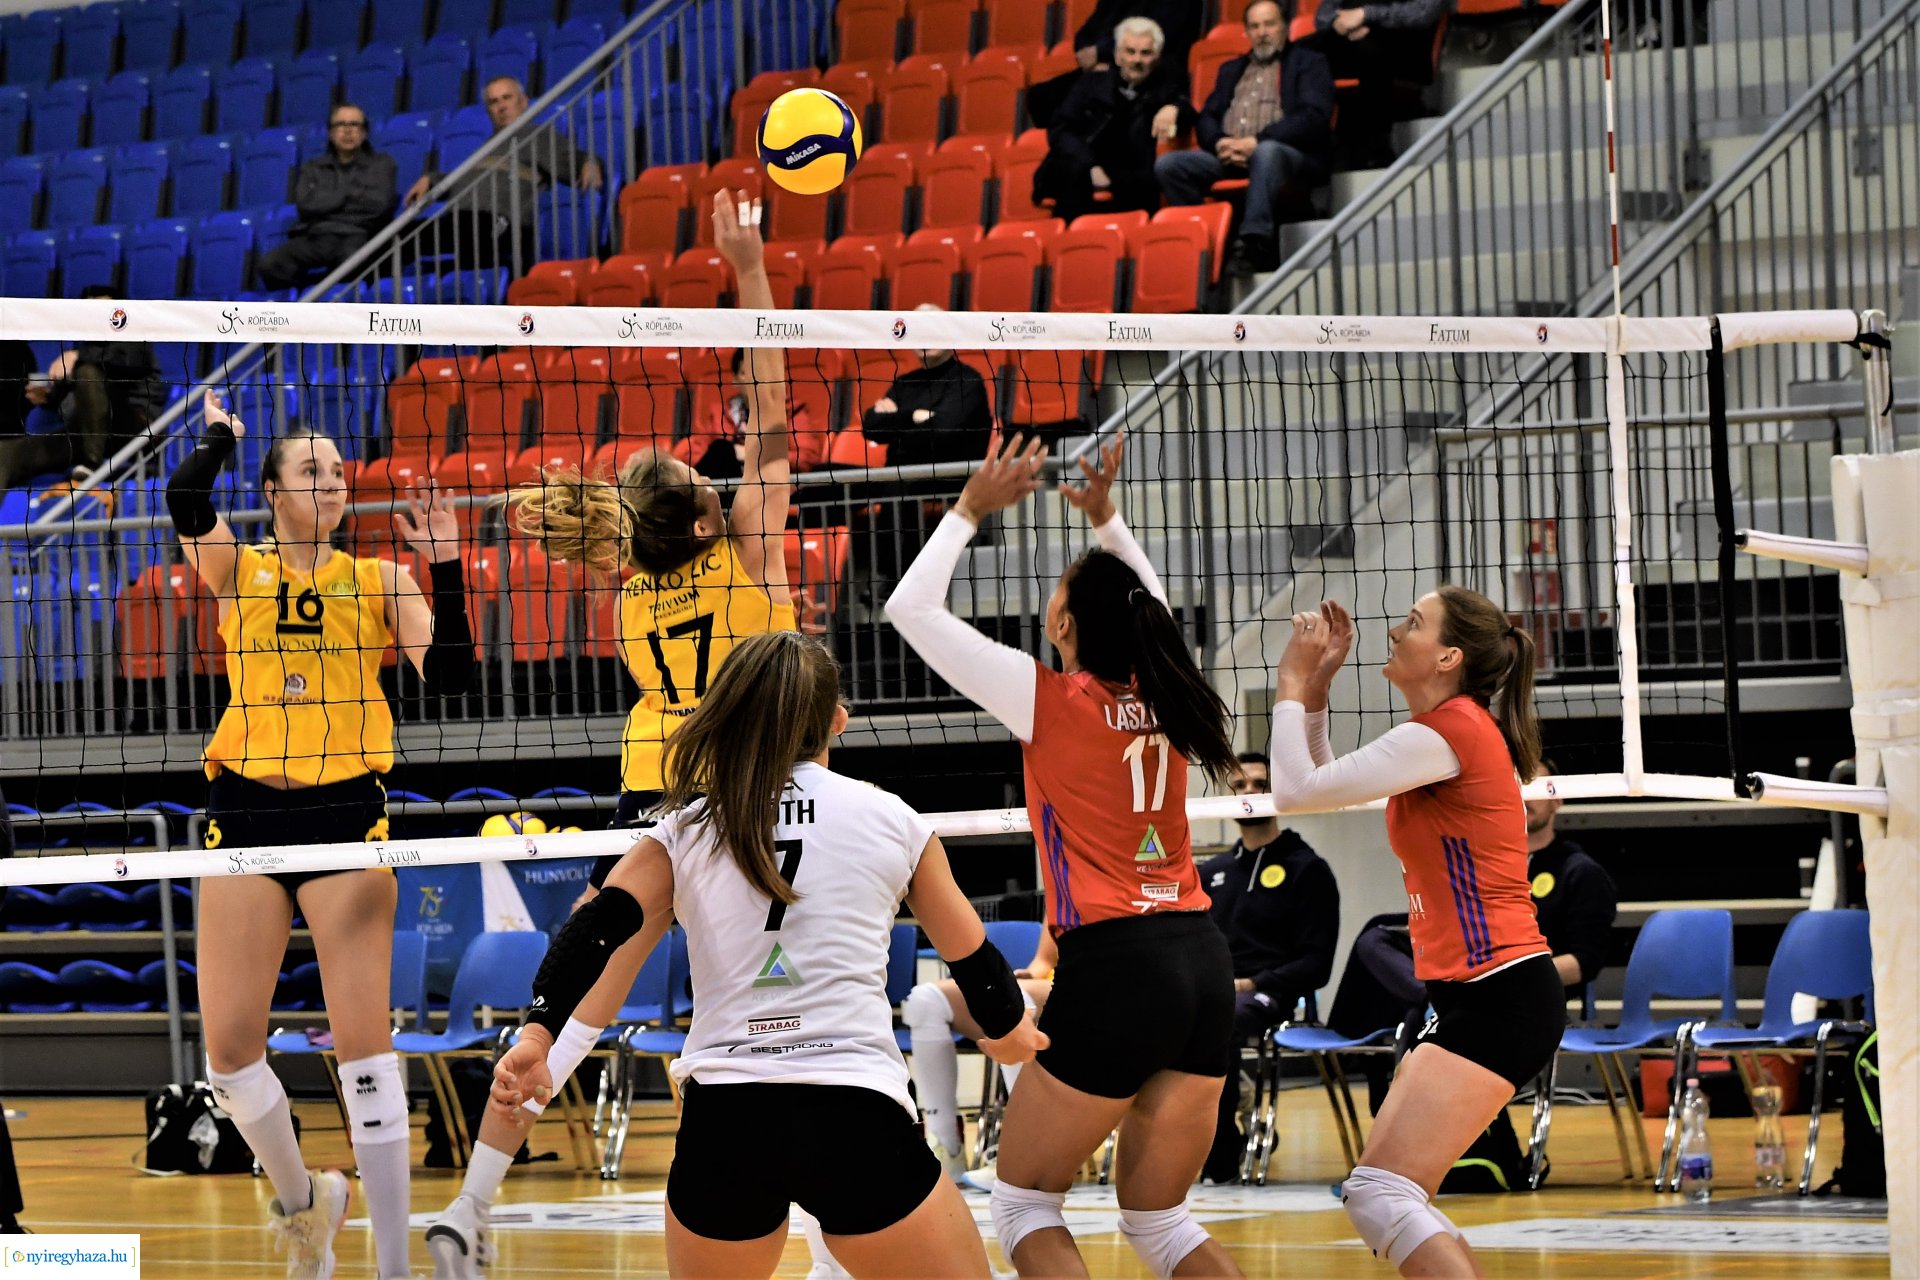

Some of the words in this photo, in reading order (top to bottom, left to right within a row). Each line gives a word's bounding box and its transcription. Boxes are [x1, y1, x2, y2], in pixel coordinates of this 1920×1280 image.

[368, 311, 422, 332] FATUM
[756, 317, 804, 337] FATUM
[1108, 320, 1153, 340] FATUM
[1429, 323, 1470, 342] FATUM
[278, 582, 325, 622] 16
[647, 612, 714, 705] 17
[1122, 733, 1170, 813] 17
[375, 847, 421, 864] FATUM
[764, 839, 803, 932] 7
[748, 1020, 801, 1033] STRABAG
[750, 1042, 834, 1055] BESTRONG
